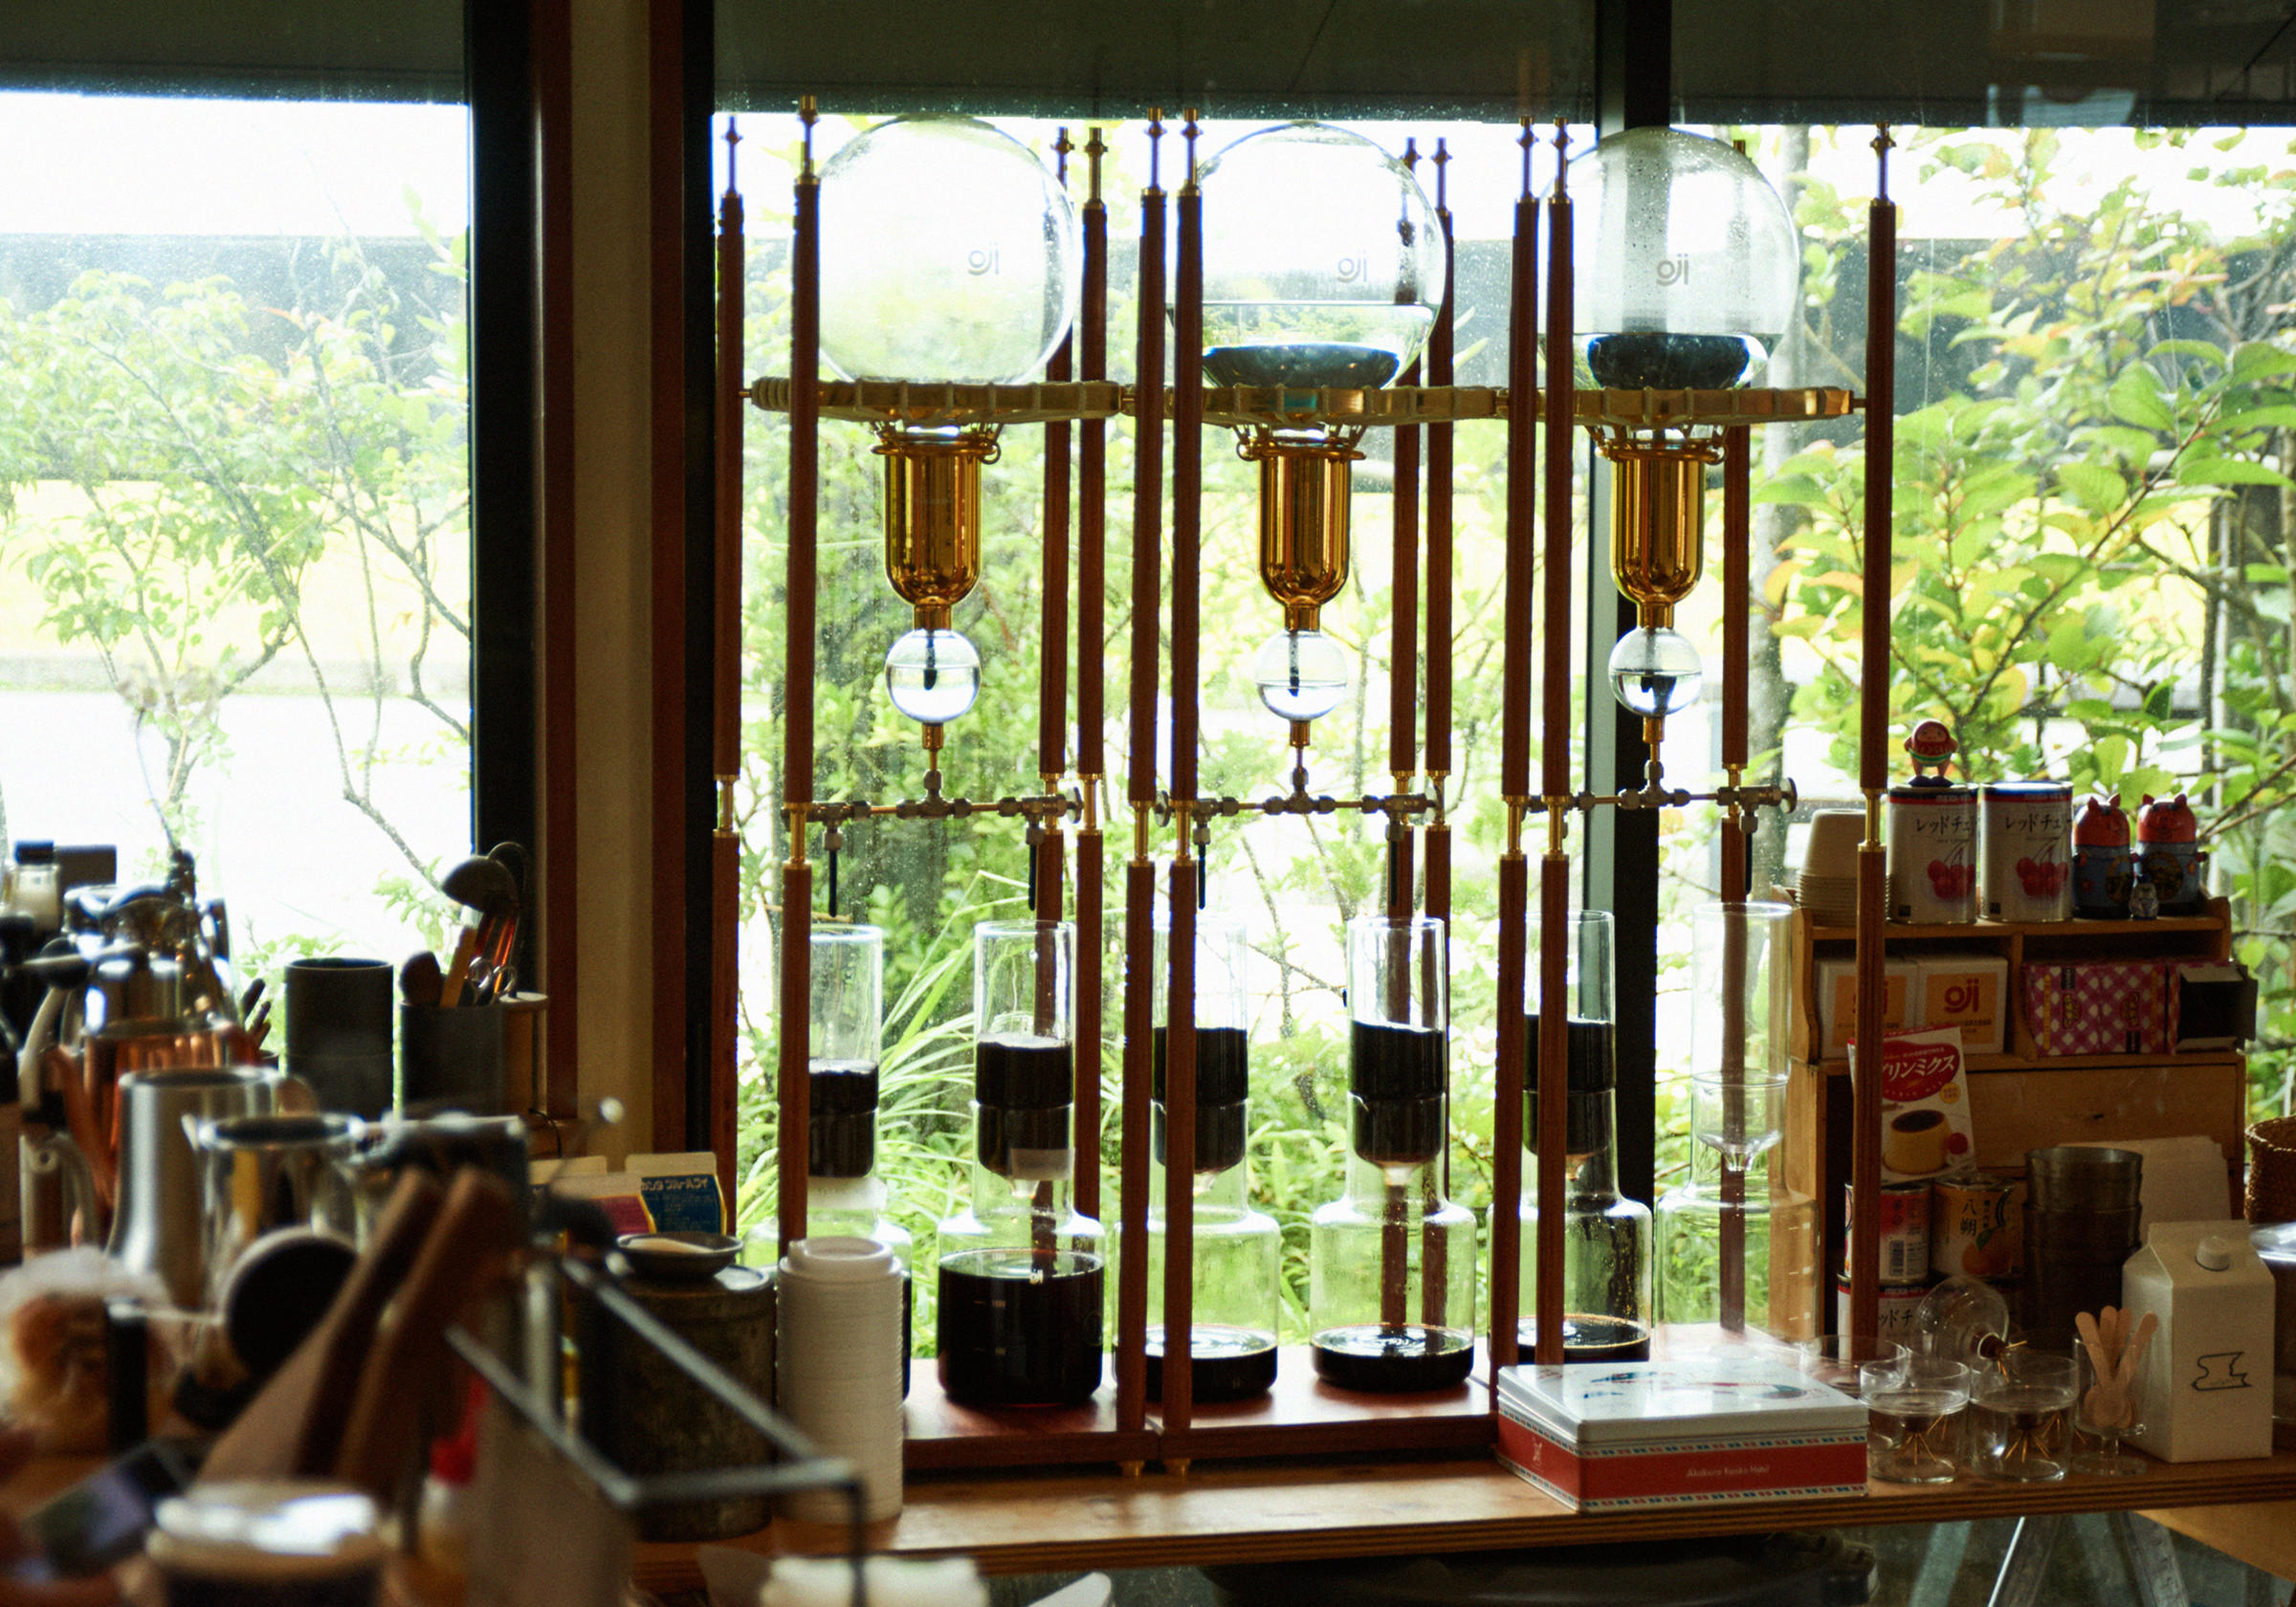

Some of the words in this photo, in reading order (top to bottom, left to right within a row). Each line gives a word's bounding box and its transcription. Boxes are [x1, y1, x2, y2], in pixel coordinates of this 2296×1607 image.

[2005, 813, 2072, 833] レッドチェ
